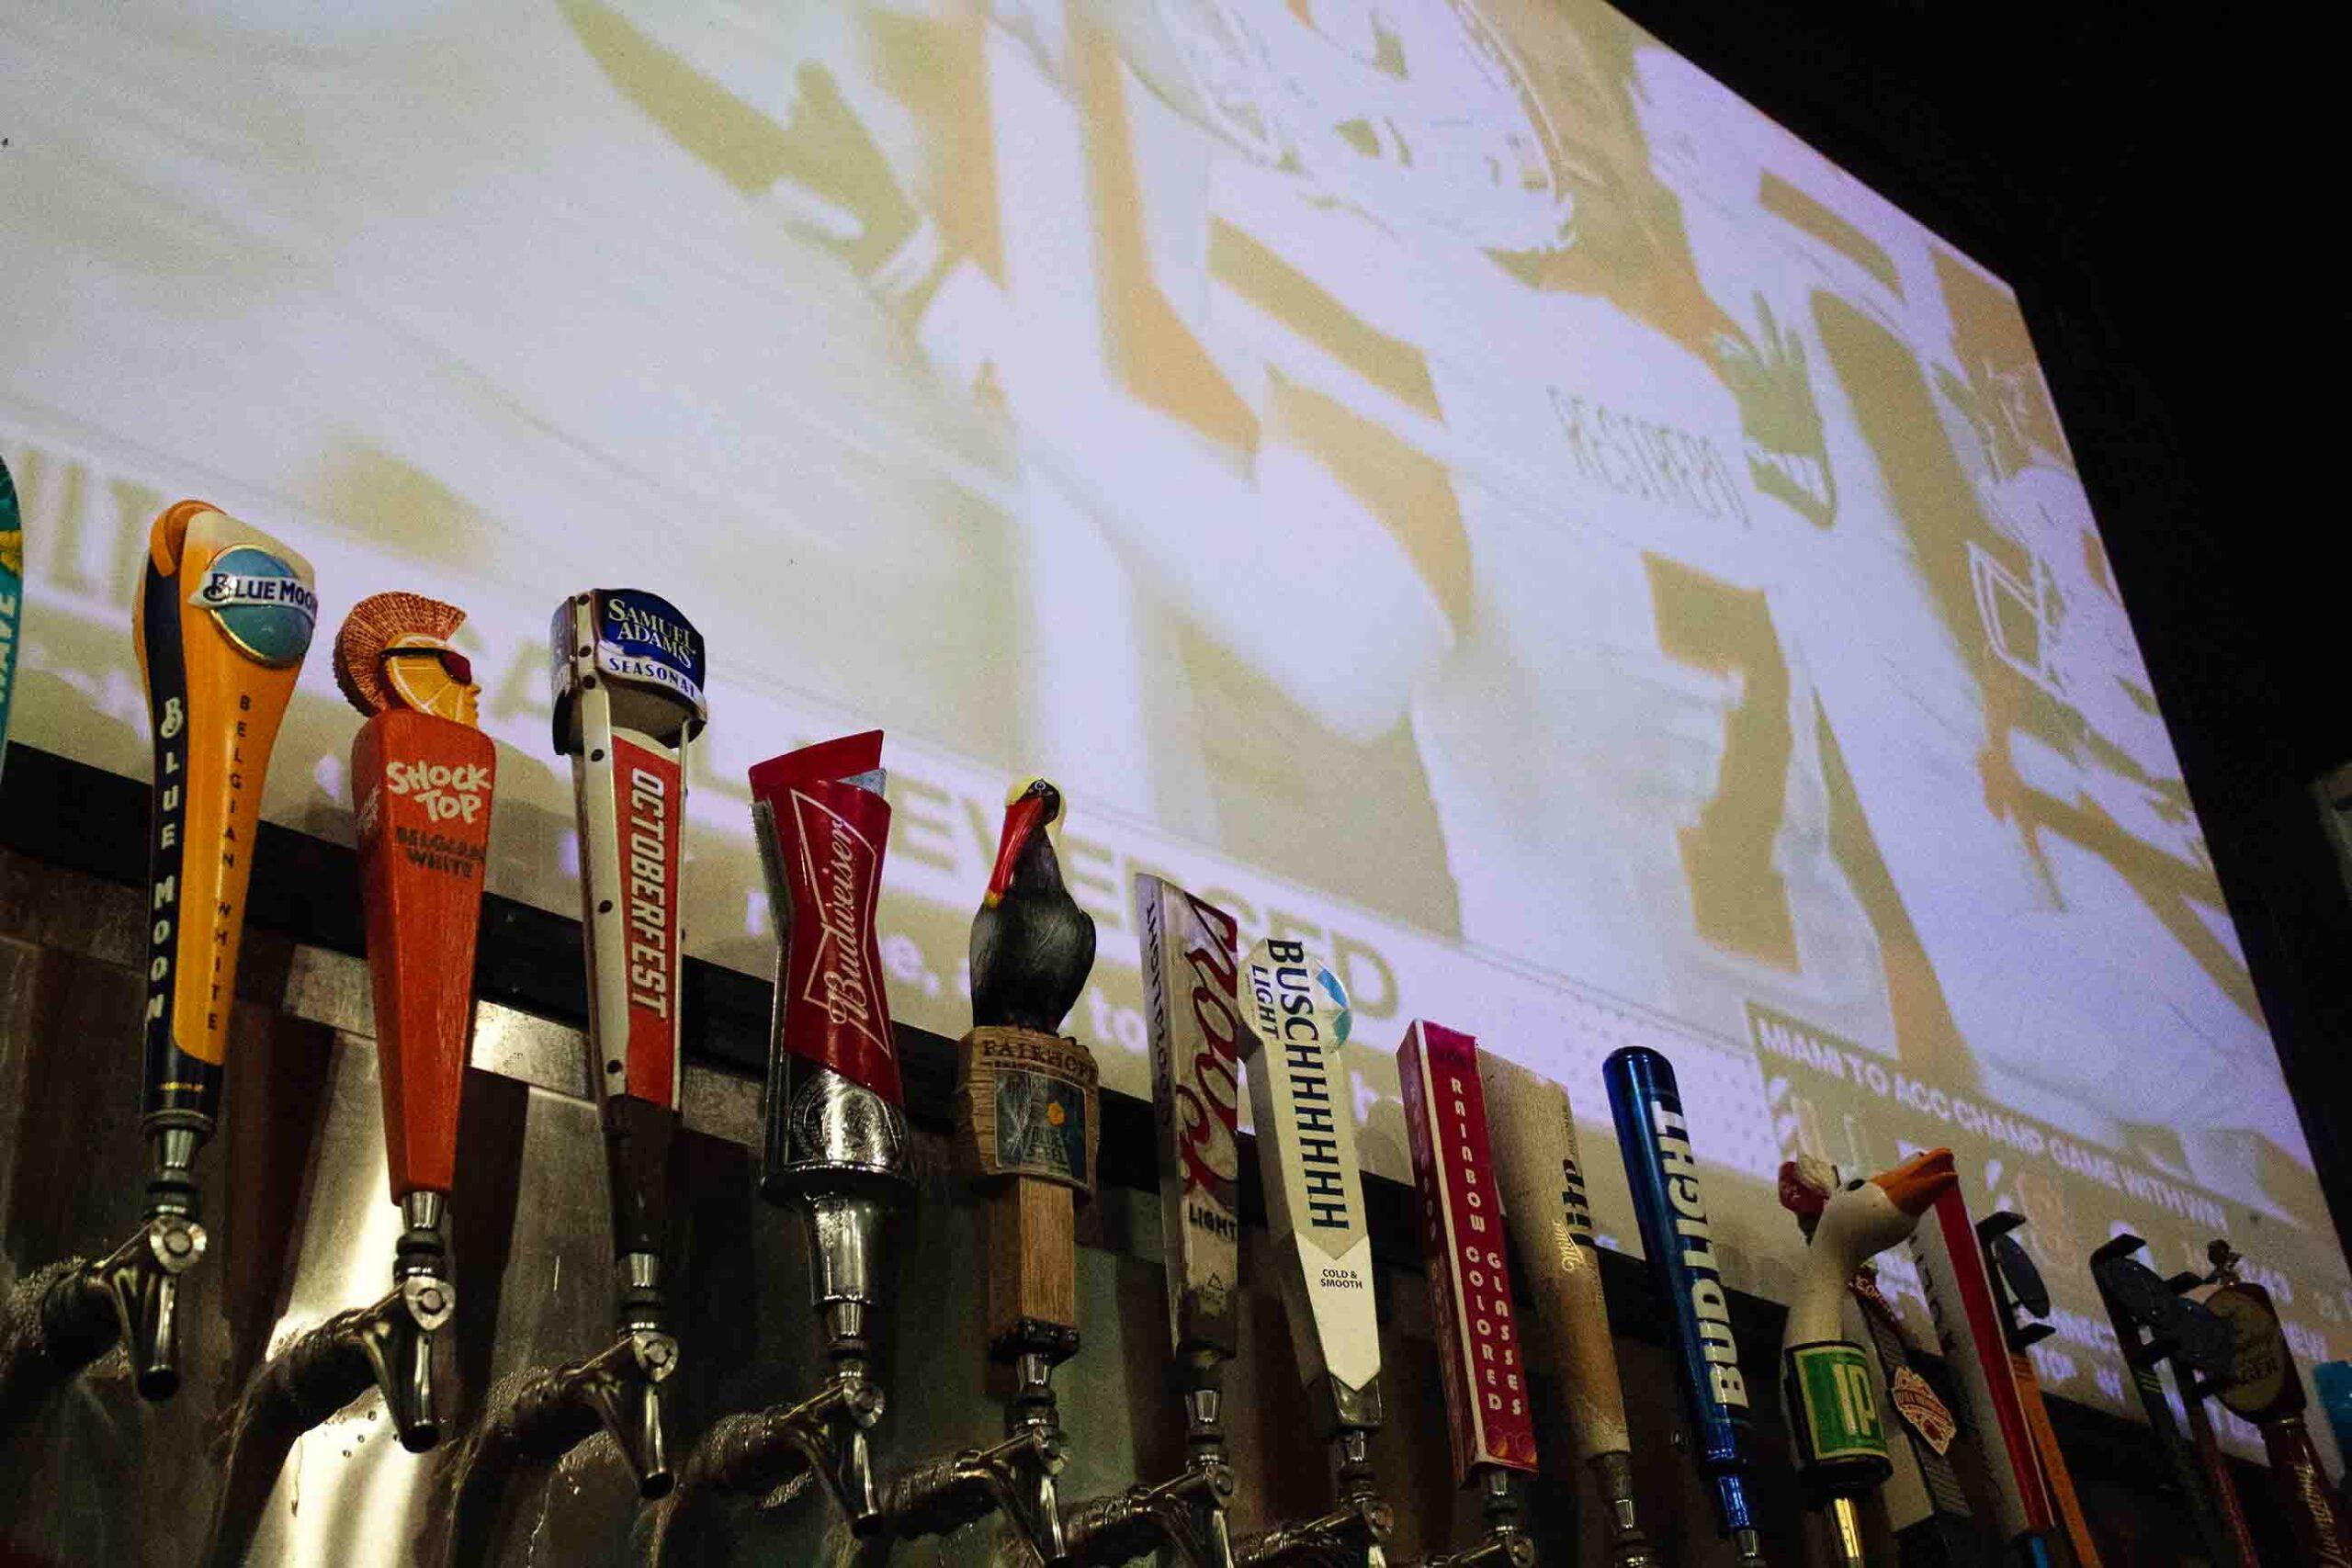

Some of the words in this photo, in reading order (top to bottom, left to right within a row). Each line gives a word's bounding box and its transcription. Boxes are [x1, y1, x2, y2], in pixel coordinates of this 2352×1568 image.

[202, 571, 277, 606] BLUE
[278, 578, 318, 623] MOO
[608, 598, 695, 654] SAMUEL
[616, 621, 692, 669] ADAMS
[160, 696, 184, 851] BLUE
[222, 694, 252, 869] BELGIAN
[385, 759, 492, 795] SHOCK
[413, 787, 483, 825] TOP
[144, 874, 175, 1028] MOON
[630, 765, 668, 1019] OCTOBERFEST
[822, 817, 870, 1025] Budweiser
[1250, 964, 1280, 1040] LIGHT
[1450, 1076, 1487, 1235] RAINBOW
[1757, 1017, 1845, 1080] MIAMI
[1844, 1052, 1890, 1098] TO
[1894, 1072, 1951, 1122] ACC
[1953, 1099, 2046, 1156] CHAMP
[2048, 1136, 2120, 1191] GAME
[1188, 1199, 1238, 1242] LIGHT
[1651, 1100, 1721, 1271] LIGHT
[1319, 1277, 1363, 1290] SMOOTH
[1321, 1268, 1350, 1280] COLD
[1350, 1269, 1358, 1280] &
[1466, 1245, 1502, 1412] COLORED
[1487, 1250, 1522, 1416] GLASSES
[1691, 1279, 1749, 1409] BUD
